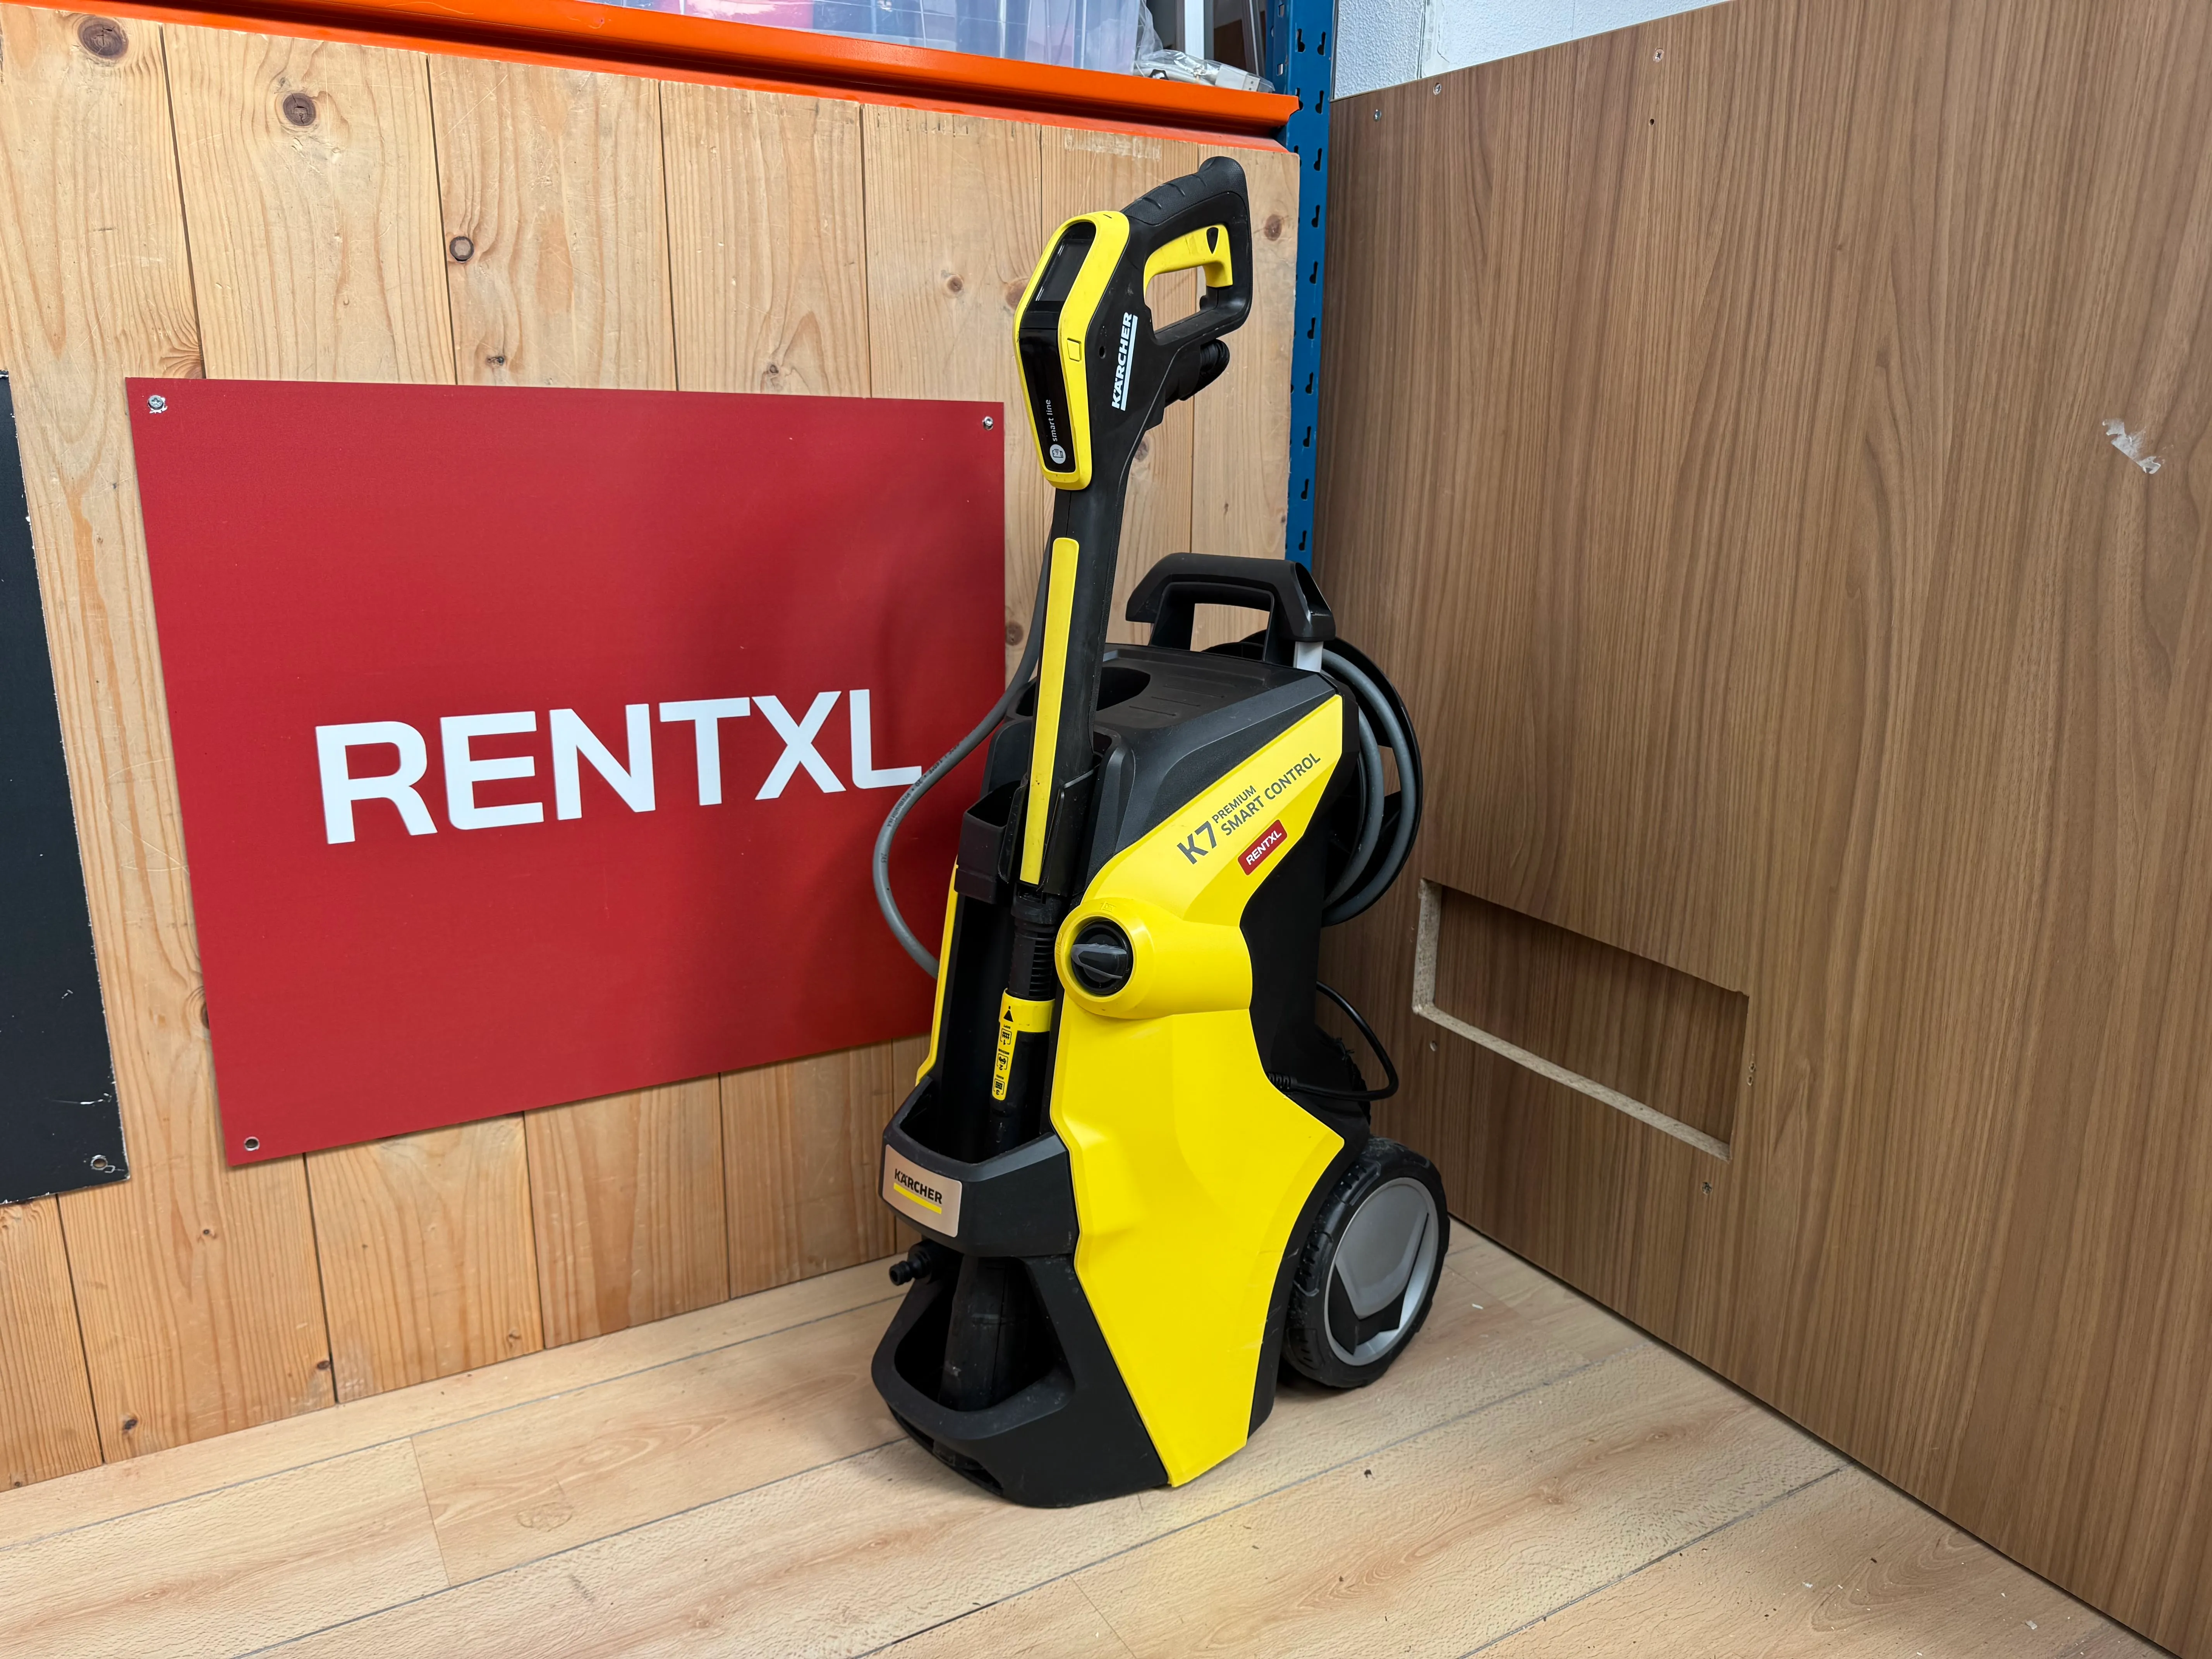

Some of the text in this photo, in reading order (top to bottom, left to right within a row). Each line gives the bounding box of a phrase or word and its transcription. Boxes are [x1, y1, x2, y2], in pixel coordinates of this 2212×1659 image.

[1112, 311, 1133, 409] KÄRCHER
[1048, 417, 1058, 441] smart
[315, 689, 922, 845] RENTXL
[1211, 785, 1257, 823] PREMIUM
[1221, 753, 1321, 836] SMART CONTROL
[1176, 821, 1217, 865] K7
[1245, 830, 1282, 866] RENTXL
[895, 1168, 942, 1204] KÄRCHER
